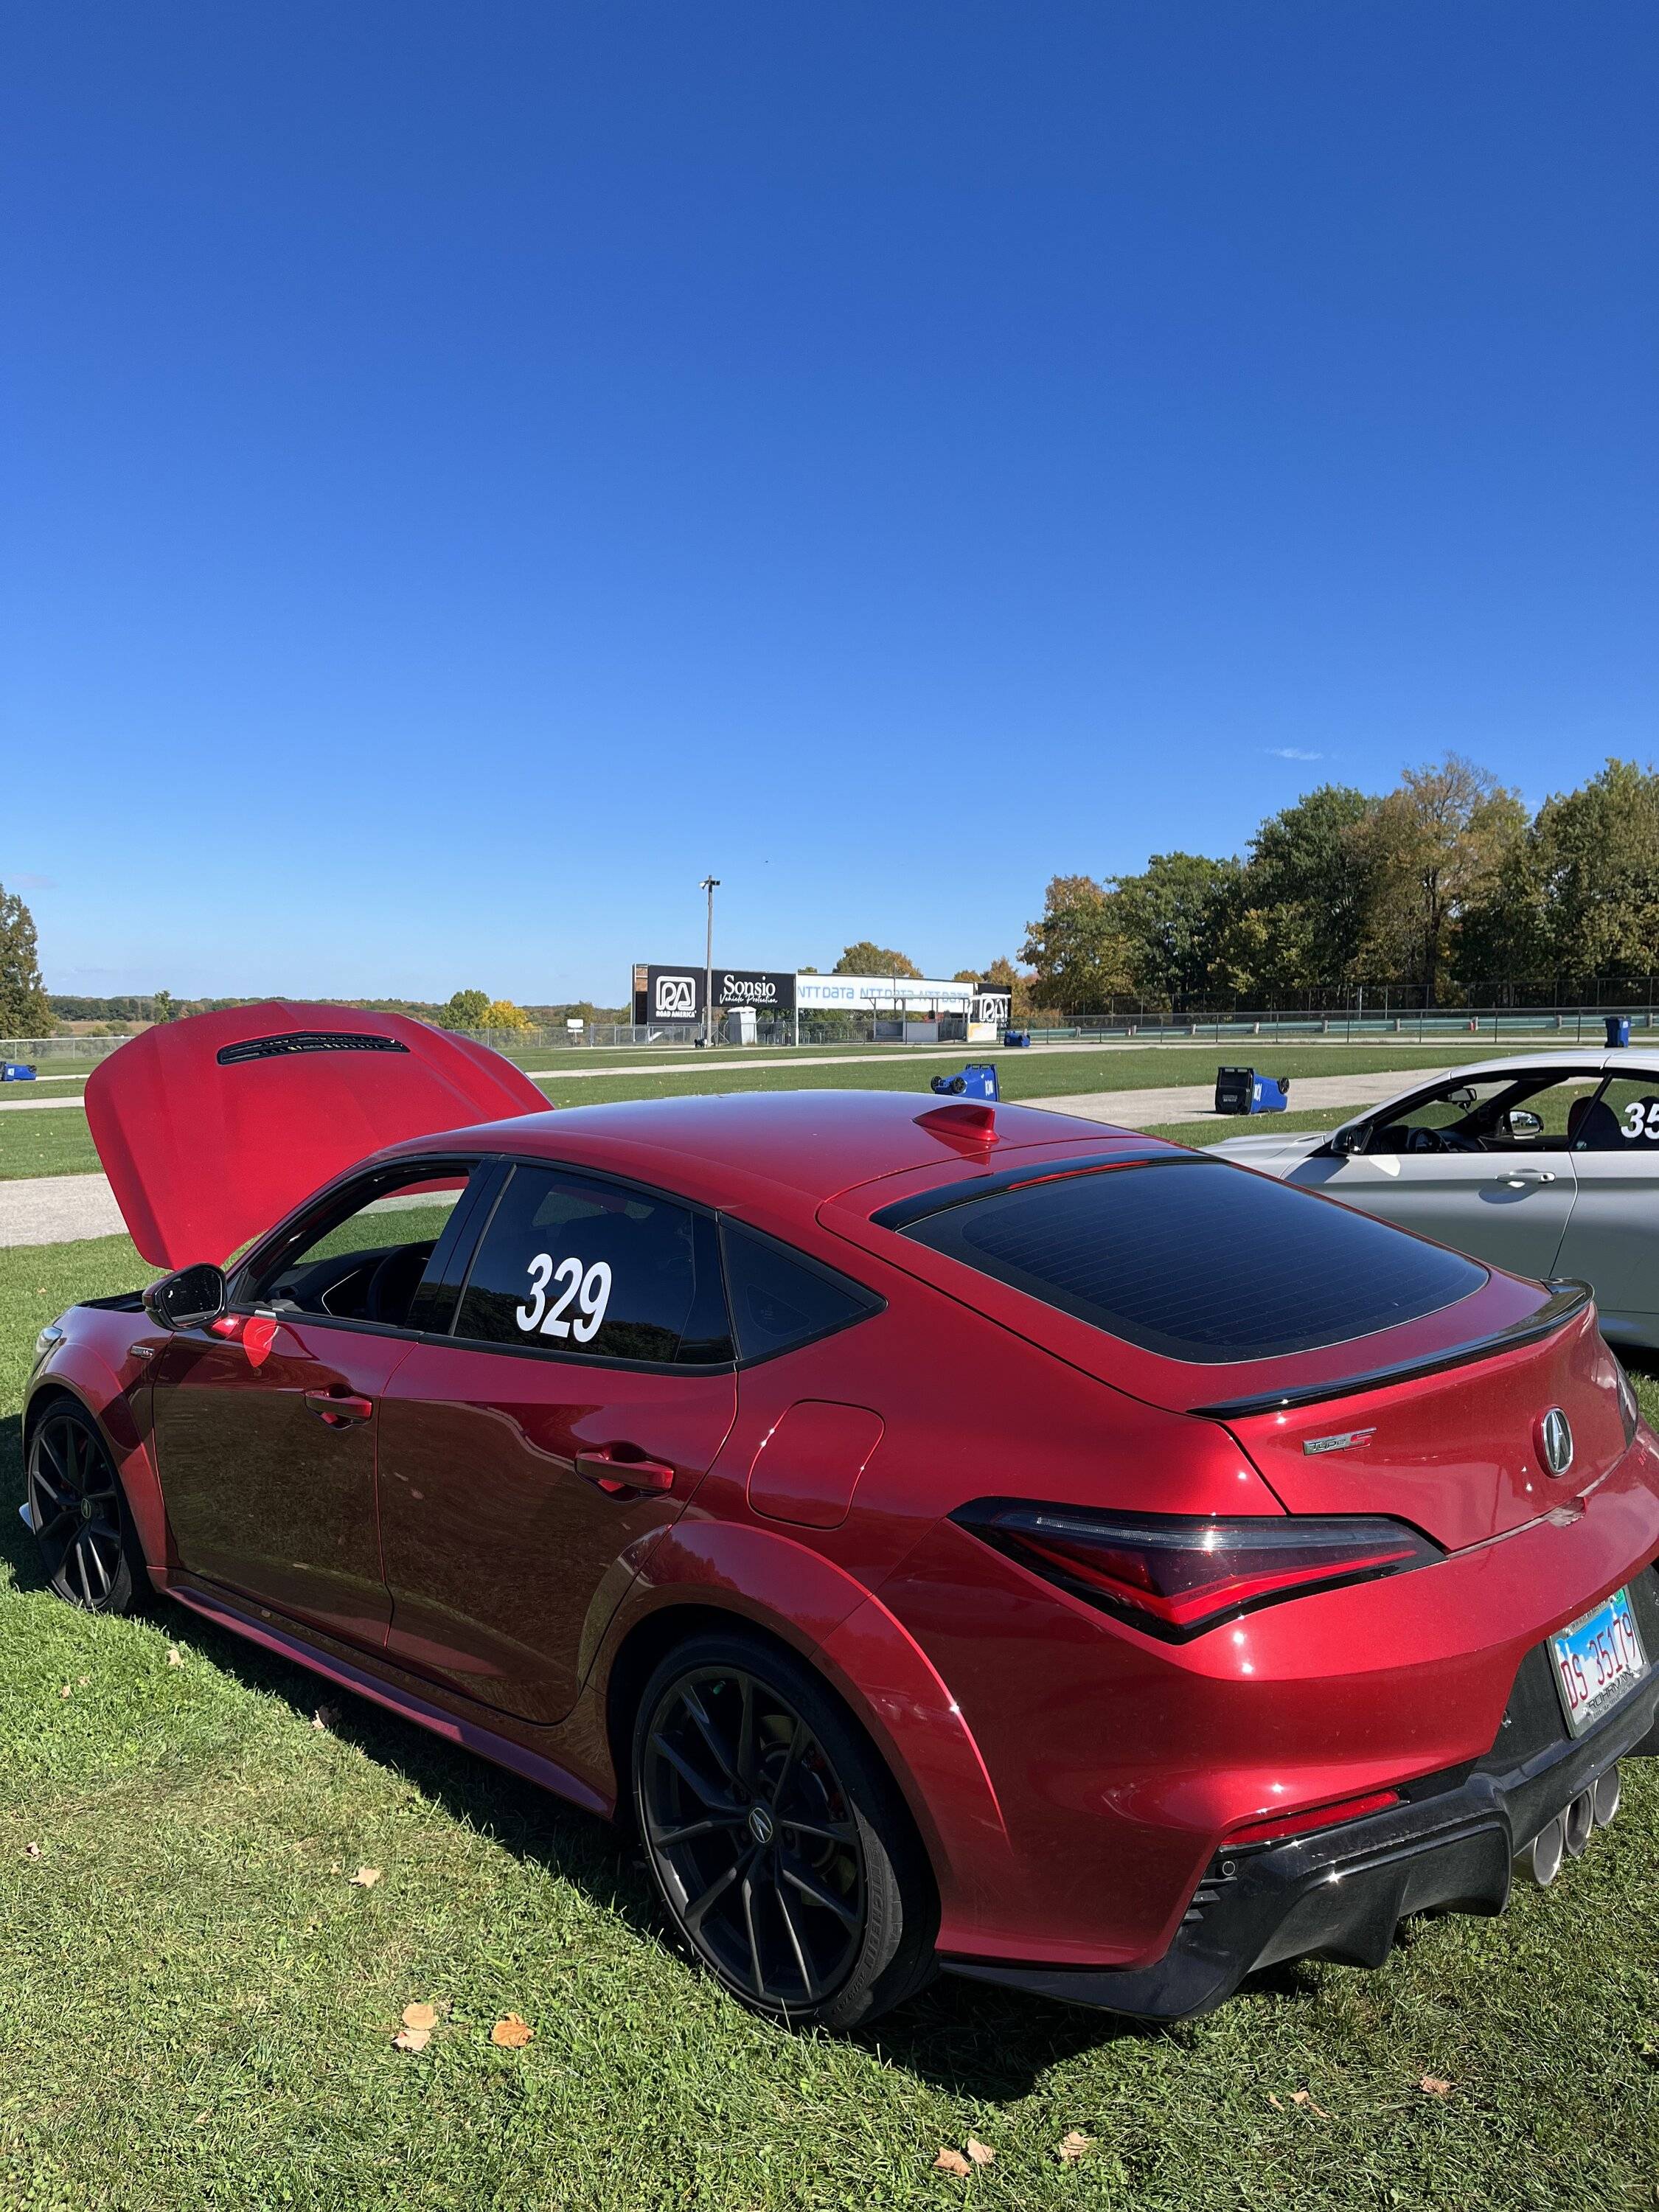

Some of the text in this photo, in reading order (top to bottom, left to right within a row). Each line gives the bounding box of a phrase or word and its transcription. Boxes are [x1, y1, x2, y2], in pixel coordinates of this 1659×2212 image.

[723, 974, 776, 997] Sonsio
[797, 986, 821, 998] NTT
[720, 992, 778, 1005] Vehicle Protection
[671, 1010, 695, 1018] AMERICA
[516, 1253, 612, 1343] 329
[1309, 1428, 1377, 1452] Type S
[1560, 1653, 1588, 1710] DS
[1589, 1612, 1636, 1686] 35179
[1587, 1669, 1634, 1708] ROHRMAN
[864, 1864, 883, 1969] MICHELIN
